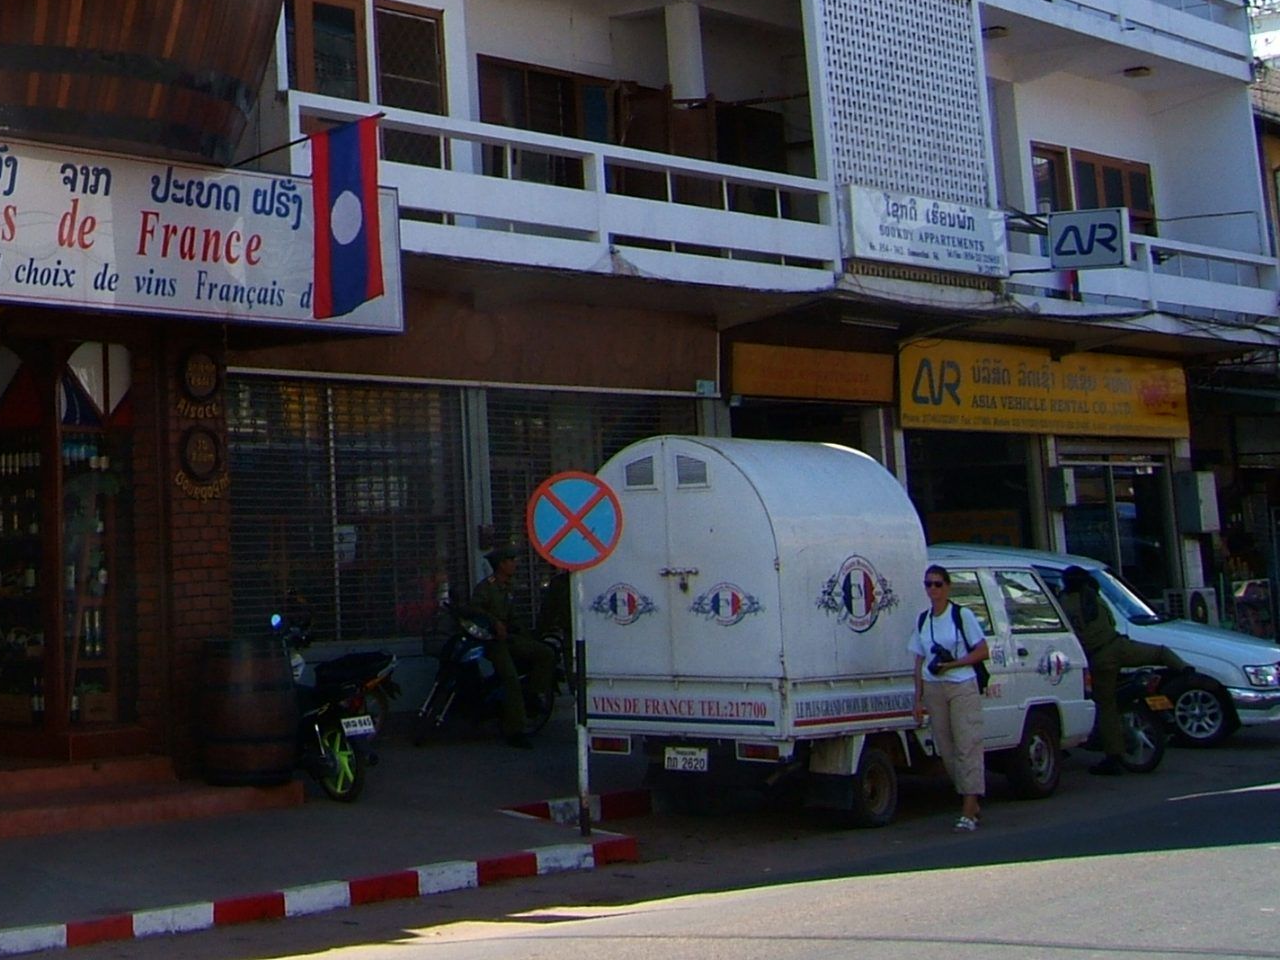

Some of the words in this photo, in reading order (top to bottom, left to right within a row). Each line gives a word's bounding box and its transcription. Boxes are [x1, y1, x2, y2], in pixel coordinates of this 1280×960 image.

[60, 162, 112, 197] ຈາກ
[151, 166, 240, 213] ປະເທດ
[57, 197, 97, 250] de
[136, 209, 263, 267] France
[918, 231, 985, 253] APPARTEMENTS
[14, 257, 76, 289] choix
[94, 262, 119, 293] de
[135, 268, 177, 298] vins
[196, 270, 286, 310] Français
[971, 395, 997, 410] ASIA
[1000, 396, 1047, 412] VEHICLE
[1049, 399, 1090, 415] RENTAL
[592, 696, 621, 713] VINS
[623, 697, 641, 714] DE
[644, 698, 696, 716] FRANCE
[682, 756, 706, 771] 2620
